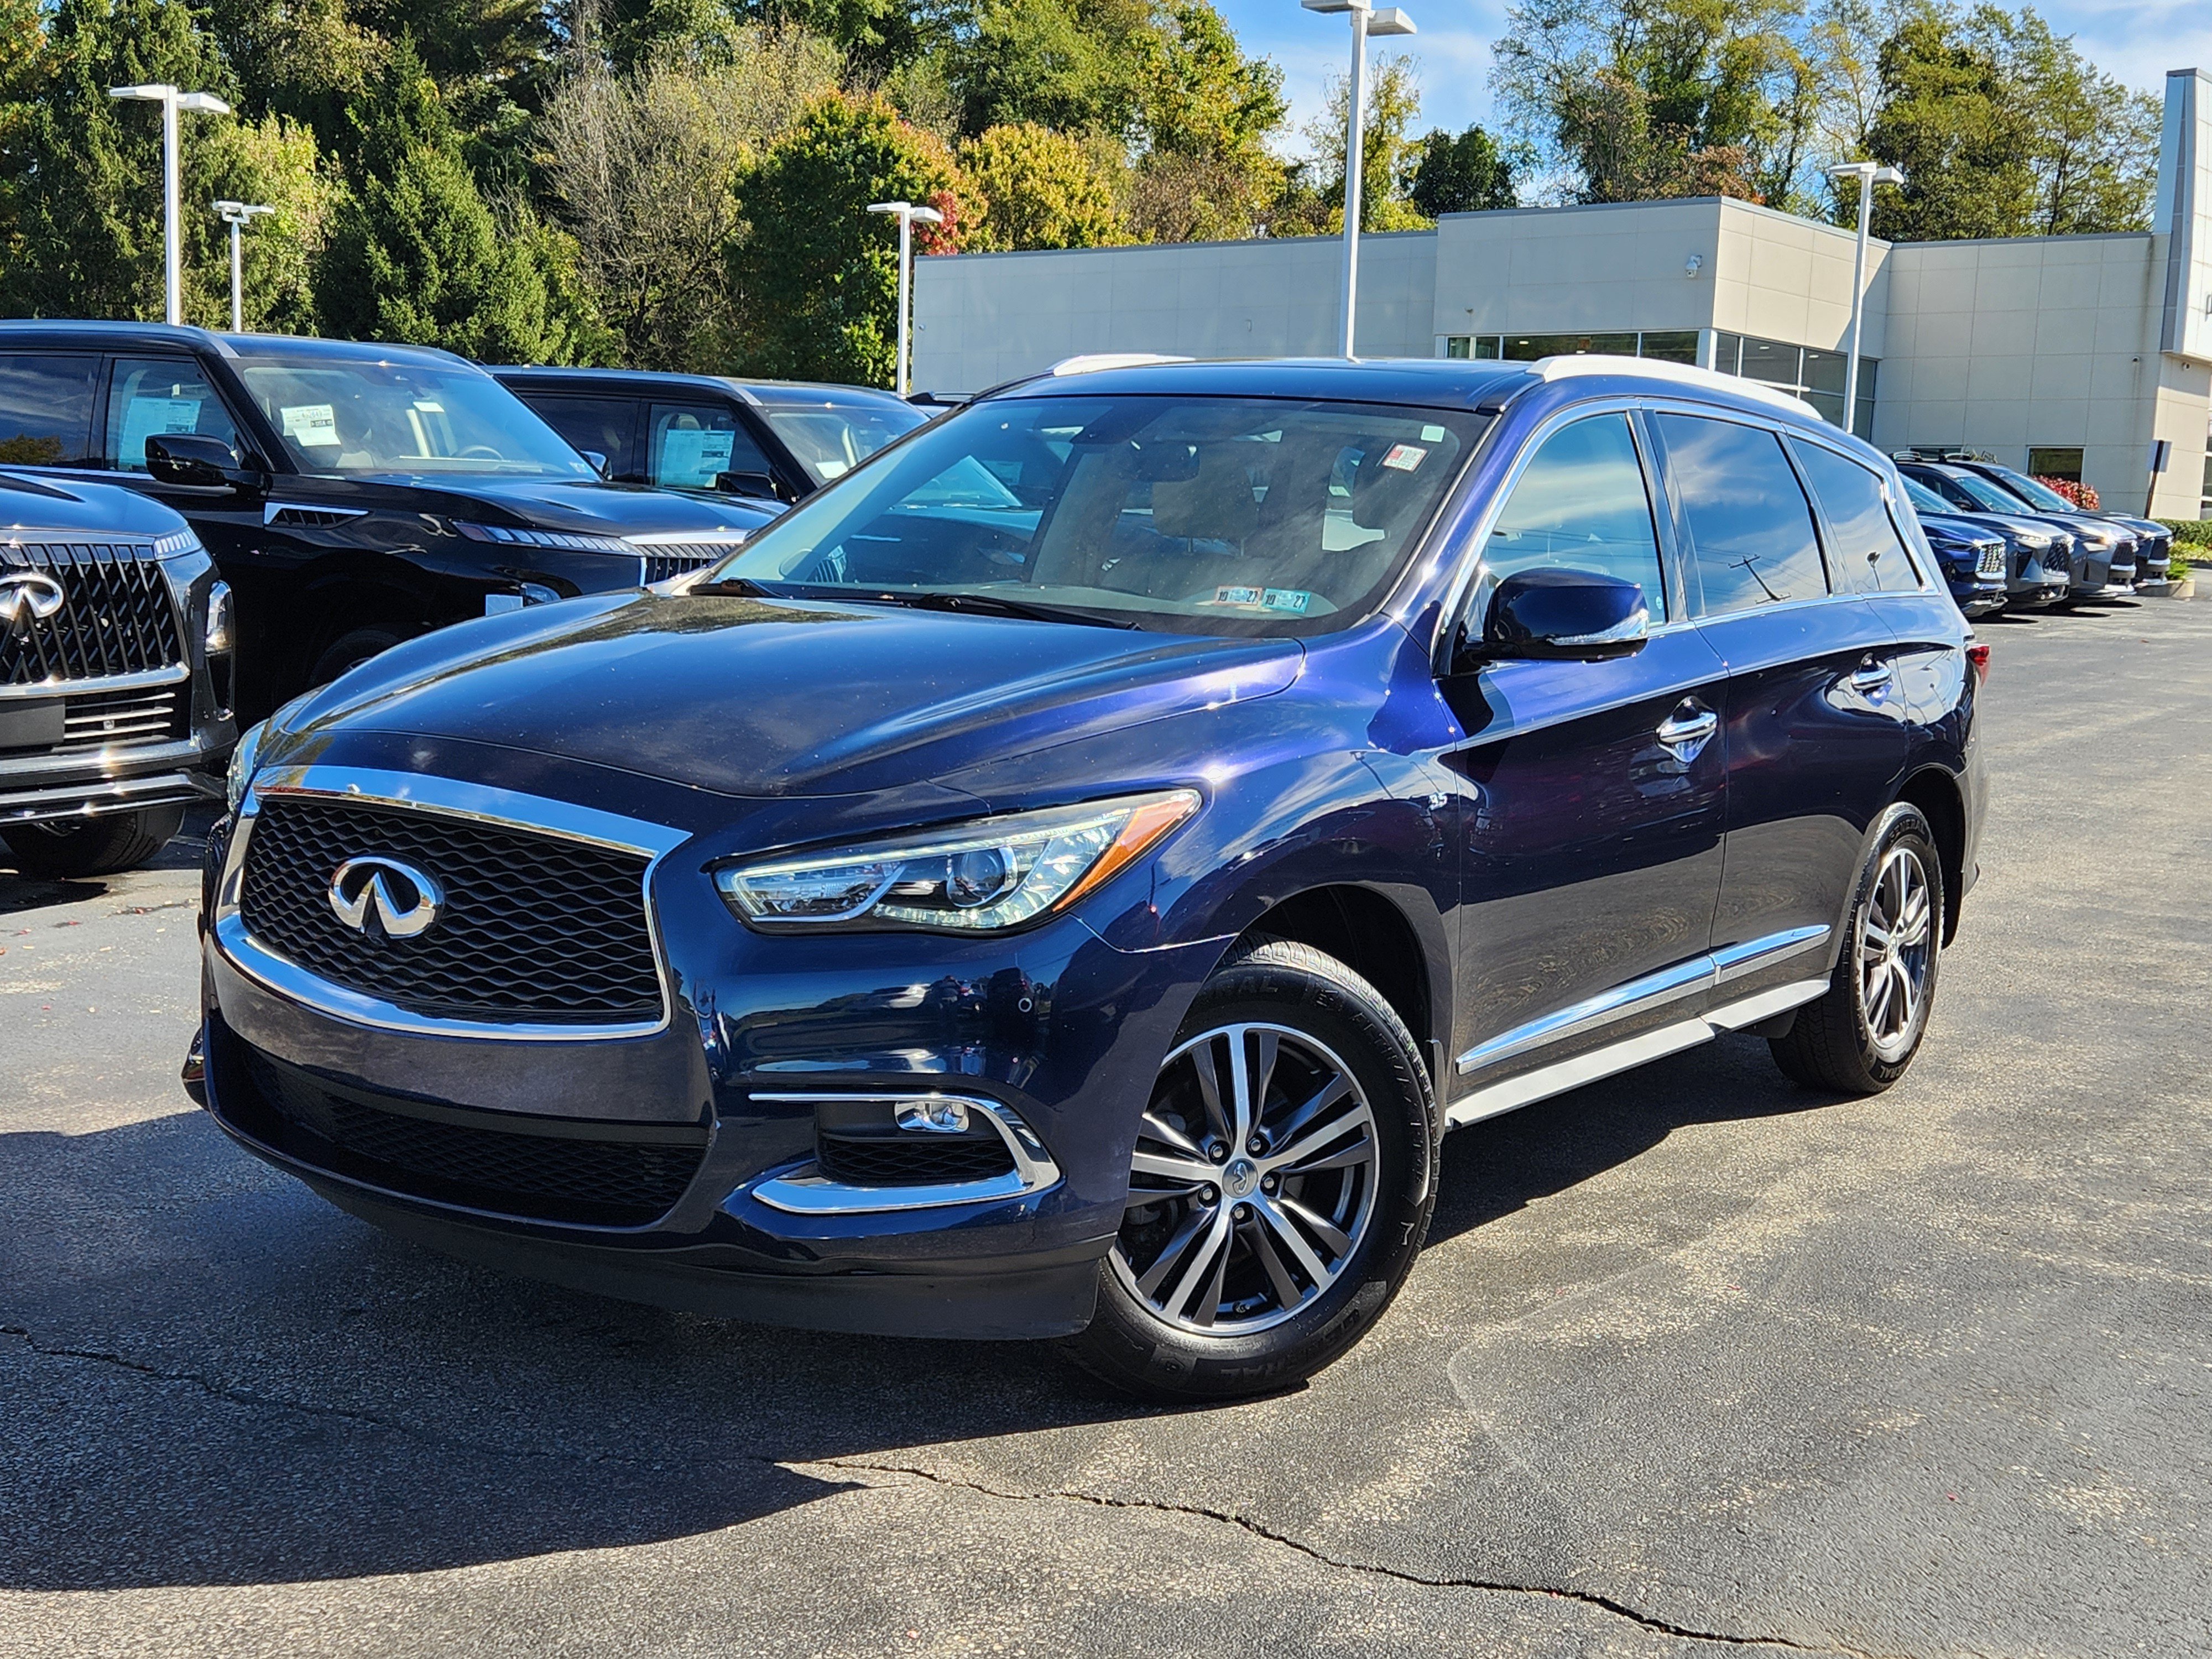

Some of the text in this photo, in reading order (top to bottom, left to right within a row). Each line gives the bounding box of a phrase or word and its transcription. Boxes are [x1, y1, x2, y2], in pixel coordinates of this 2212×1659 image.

[1218, 589, 1258, 604] 10 27
[1265, 594, 1305, 609] 10 27
[1889, 818, 1925, 843] GENERAL
